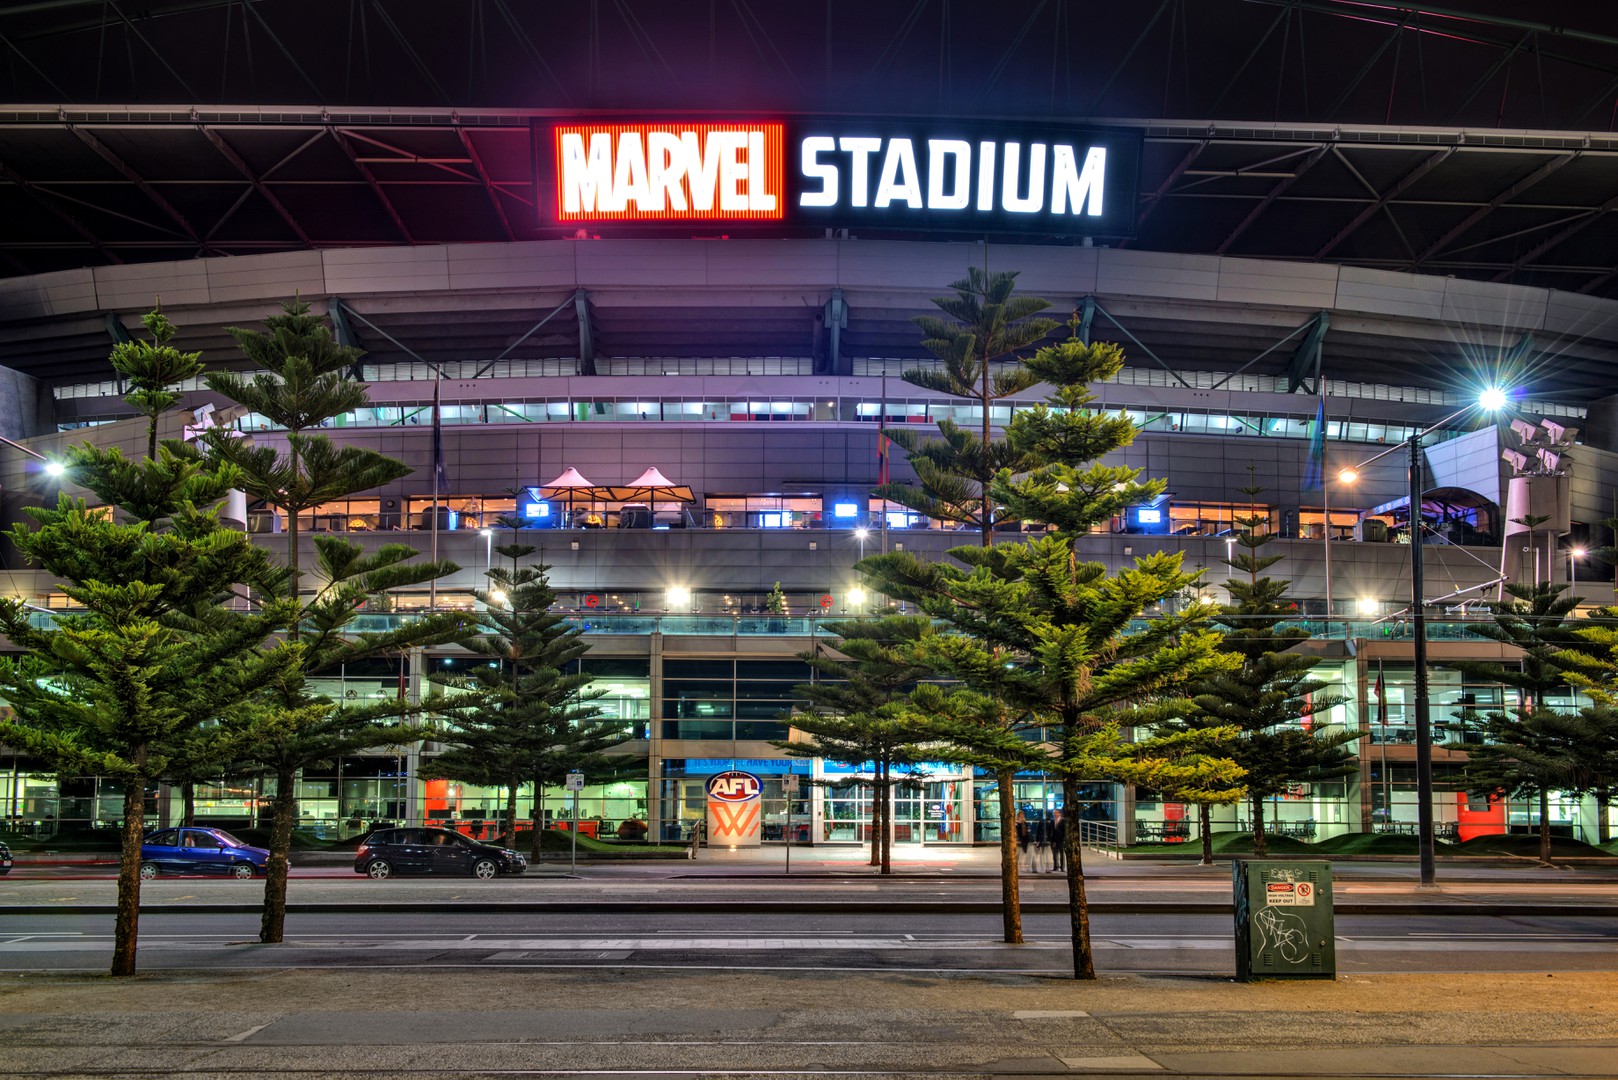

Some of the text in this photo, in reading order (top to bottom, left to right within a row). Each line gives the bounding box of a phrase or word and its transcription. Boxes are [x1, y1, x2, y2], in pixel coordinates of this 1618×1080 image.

[561, 130, 1107, 216] MARVEL STADIUM
[746, 759, 769, 767] HAVE
[771, 759, 792, 767] YOUR
[709, 778, 760, 795] AFL
